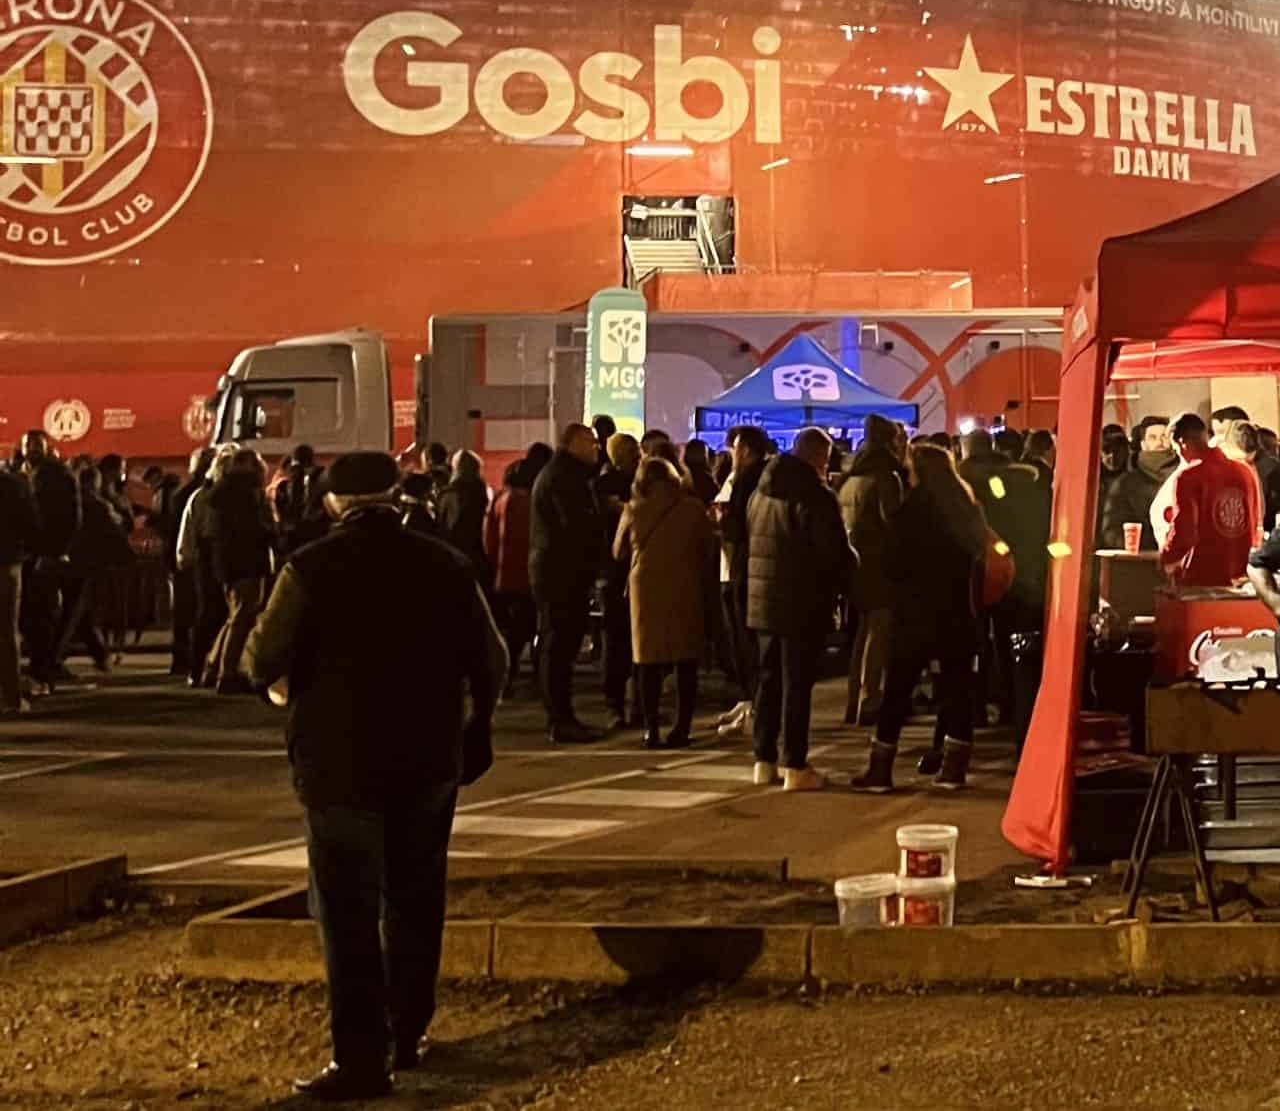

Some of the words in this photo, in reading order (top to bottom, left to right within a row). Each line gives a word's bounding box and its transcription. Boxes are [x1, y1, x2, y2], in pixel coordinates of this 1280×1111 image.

[1179, 0, 1193, 20] A
[1196, 3, 1280, 36] MONTILIVI
[343, 10, 782, 144] Gosbi
[1024, 75, 1257, 156] ESTRELLA
[1113, 146, 1190, 181] DAMM
[0, 218, 68, 246] BOL
[81, 193, 154, 240] CLUB
